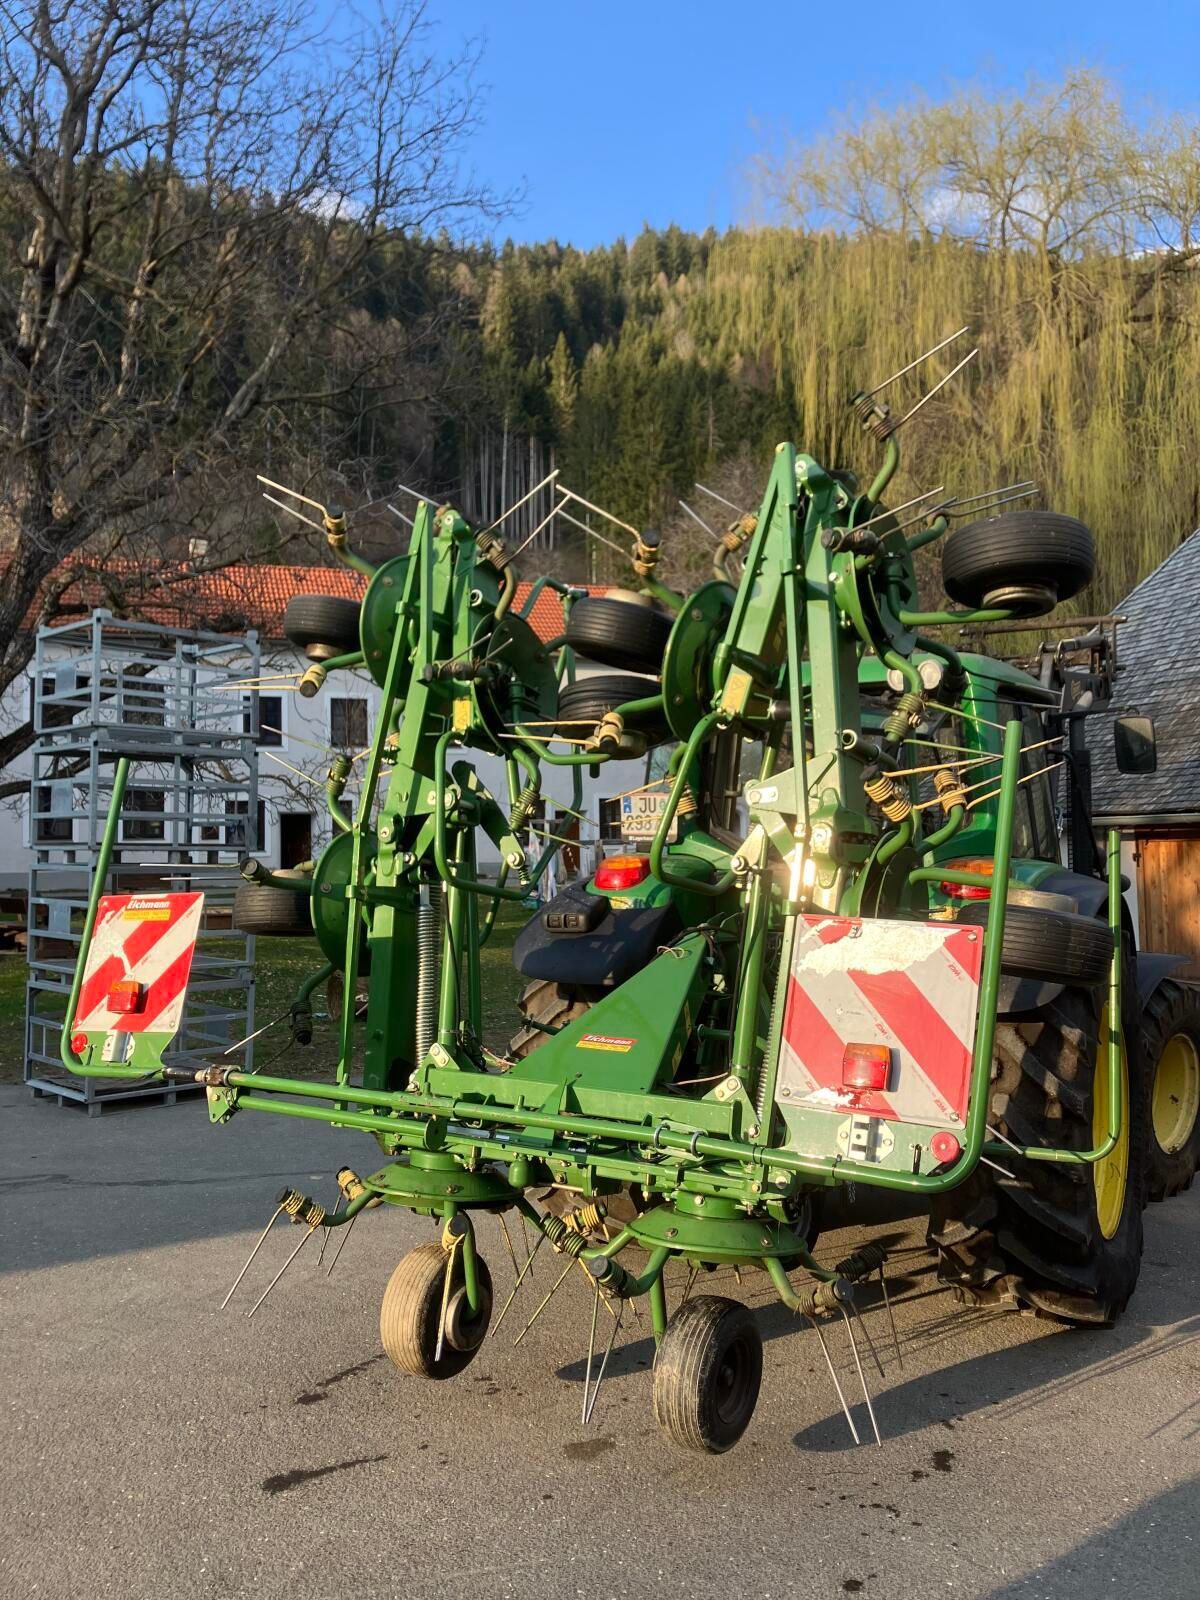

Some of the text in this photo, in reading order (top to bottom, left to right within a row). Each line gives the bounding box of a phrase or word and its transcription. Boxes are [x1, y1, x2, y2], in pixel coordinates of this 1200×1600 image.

[639, 797, 656, 813] JU
[127, 900, 170, 909] Eichmann
[585, 1035, 632, 1044] Eichmann
